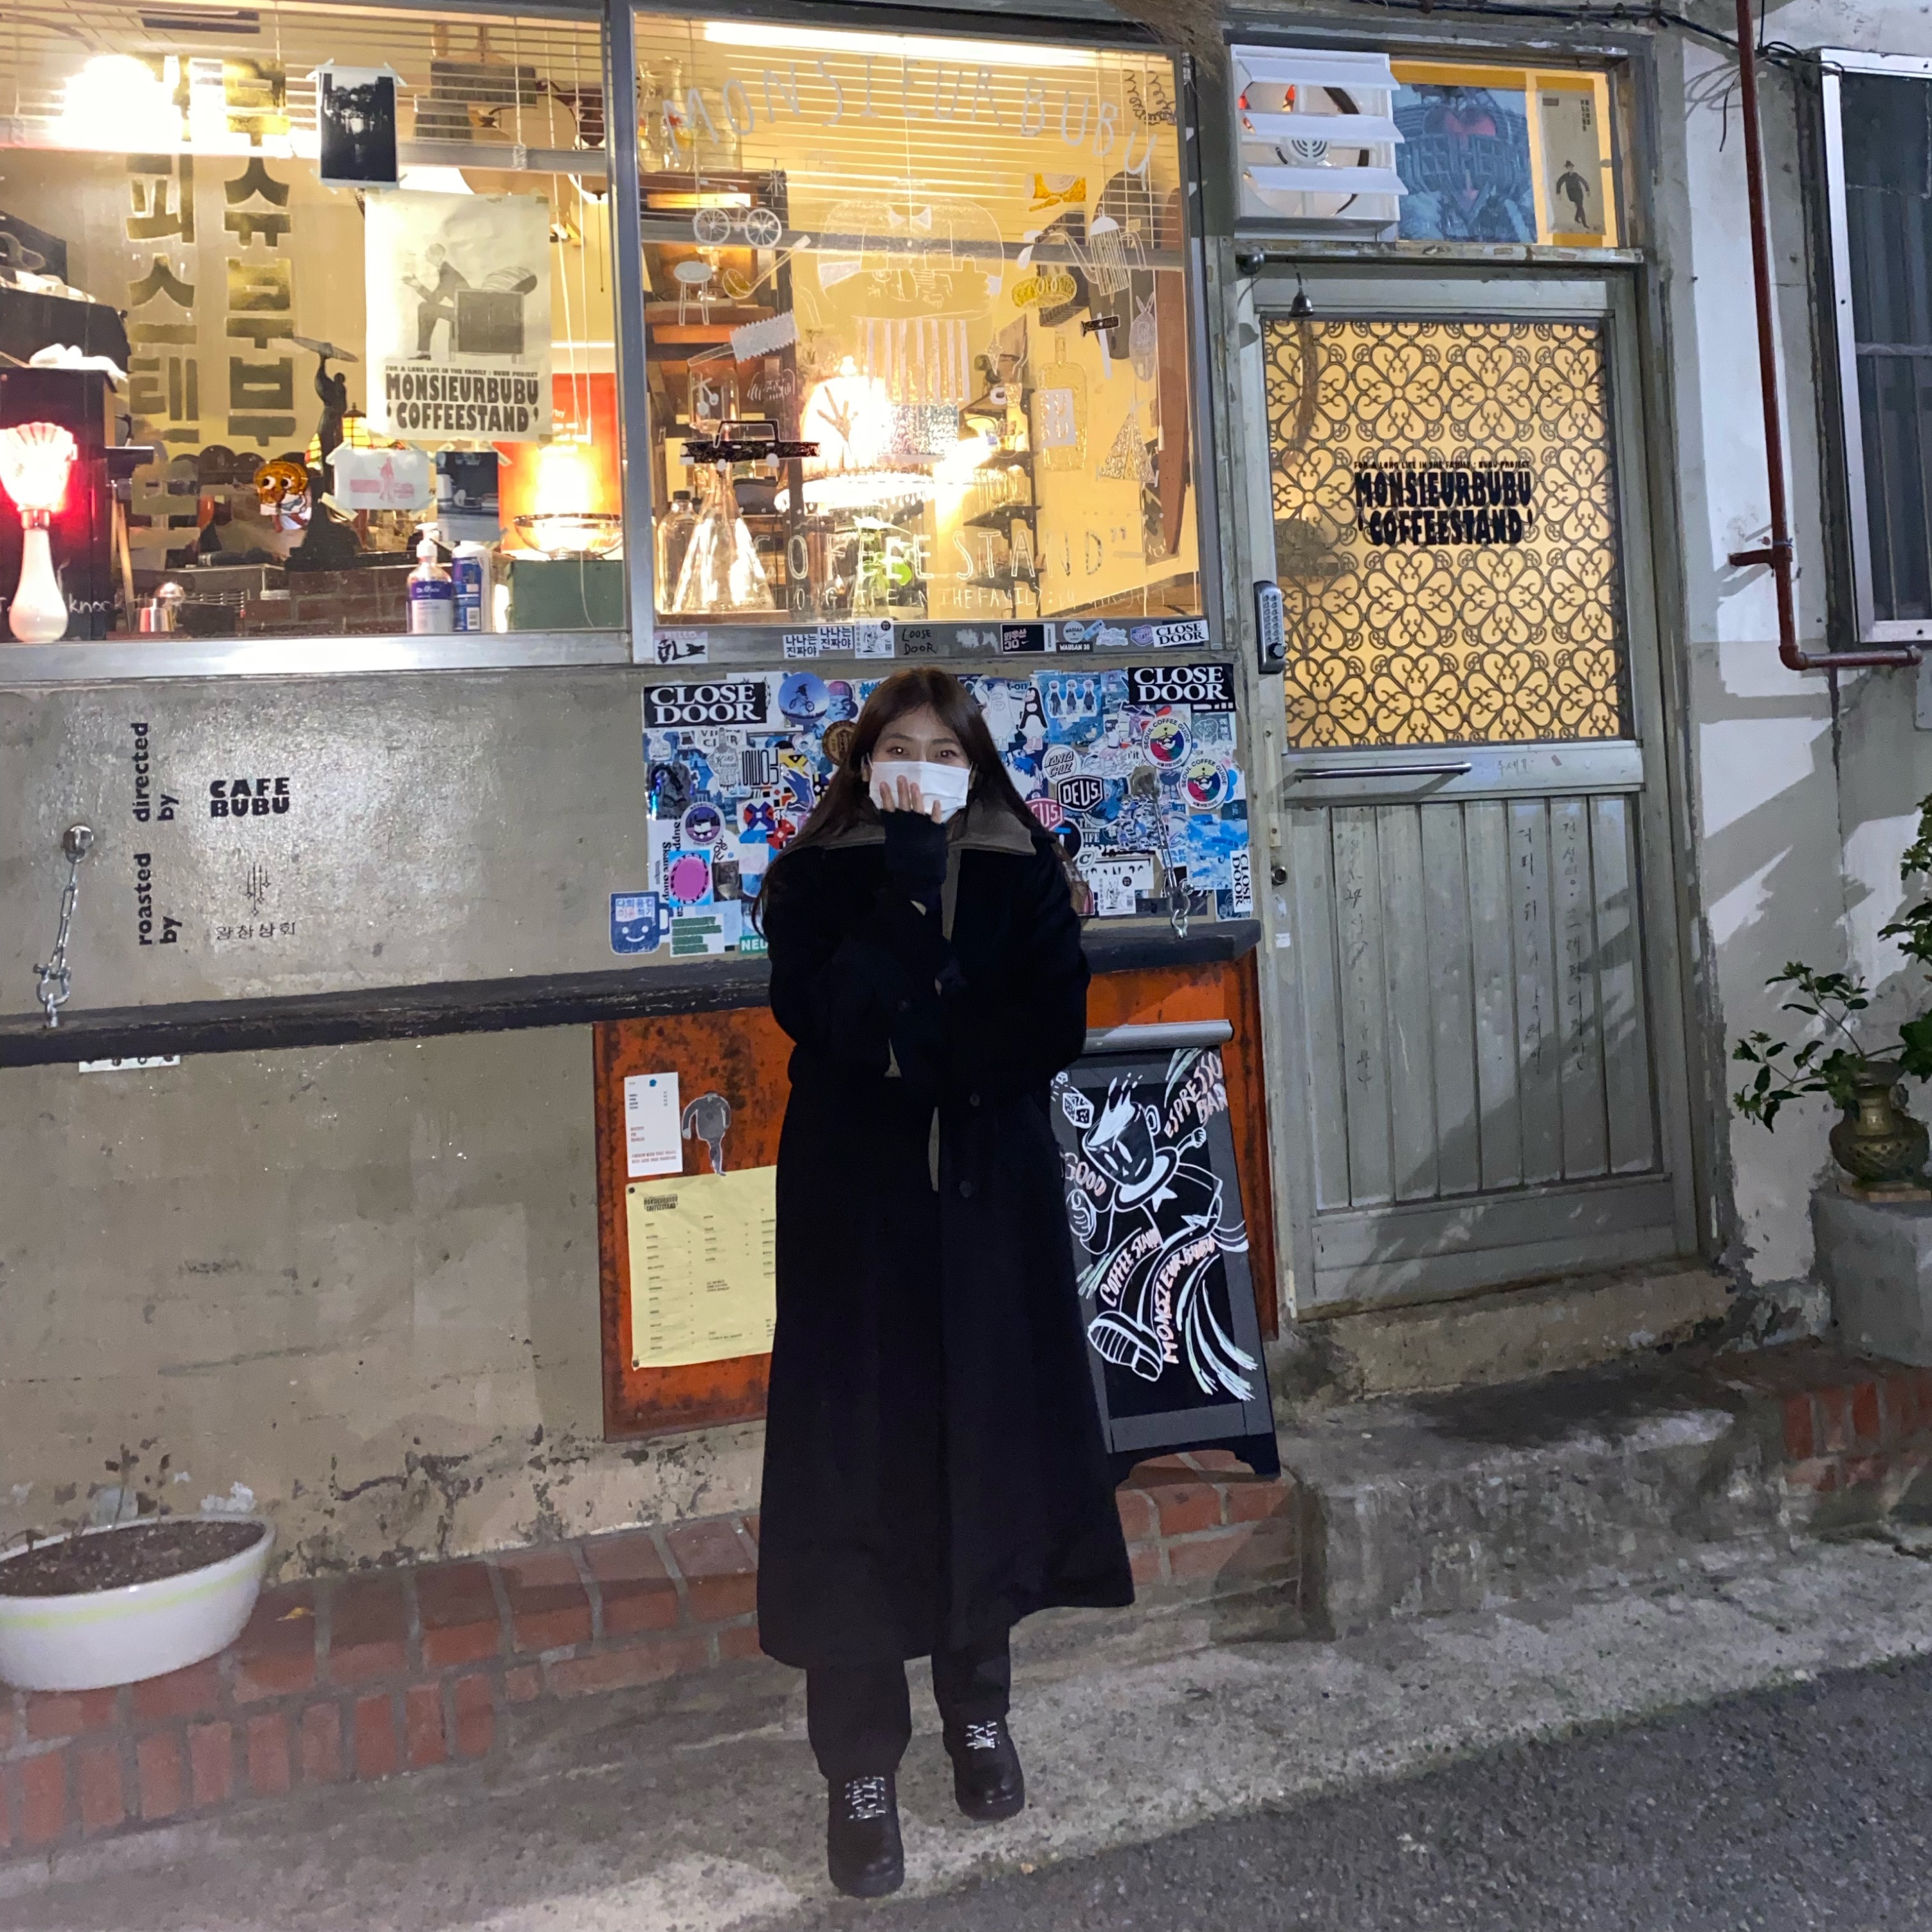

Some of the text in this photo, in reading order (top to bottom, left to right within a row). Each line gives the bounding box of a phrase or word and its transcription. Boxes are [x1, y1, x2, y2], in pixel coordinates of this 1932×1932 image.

[663, 54, 1157, 192] MONSIEUR BUBU
[385, 373, 538, 405] MONSIEURBUBU
[1354, 471, 1531, 508] MONSIEURBUBU
[785, 635, 817, 646] 나나는
[820, 626, 851, 638] 나나는
[1156, 622, 1202, 637] CLOSE
[1160, 631, 1206, 645] DOOR
[786, 646, 817, 658] 진짜야
[821, 638, 852, 649] 진짜야
[904, 642, 937, 656] DOOR
[1004, 640, 1020, 650] 30
[1134, 666, 1224, 686] CLOSE
[650, 684, 756, 706] CLOSE
[1138, 683, 1229, 702] DOOR
[654, 703, 762, 724] DOOR
[1144, 718, 1190, 749] SEOUL COFFEE GUIDE
[1044, 751, 1074, 768] SANTA
[1049, 762, 1073, 778] CRUZ
[132, 723, 149, 823] directed
[1181, 758, 1227, 788] SEOUL COFFEE GUIDE
[210, 777, 290, 798] CAFE
[157, 793, 180, 822] by
[210, 796, 290, 817] BUBU
[1232, 857, 1244, 907] DOOR
[1239, 854, 1252, 907] CLOSE
[134, 852, 153, 946] roasted
[159, 916, 183, 944] by
[1163, 1051, 1223, 1138] ESPRESSO
[1196, 1082, 1229, 1125] BAR
[1100, 1248, 1135, 1308] COFFEE
[1154, 1234, 1215, 1365] MONSIEURBUBU
